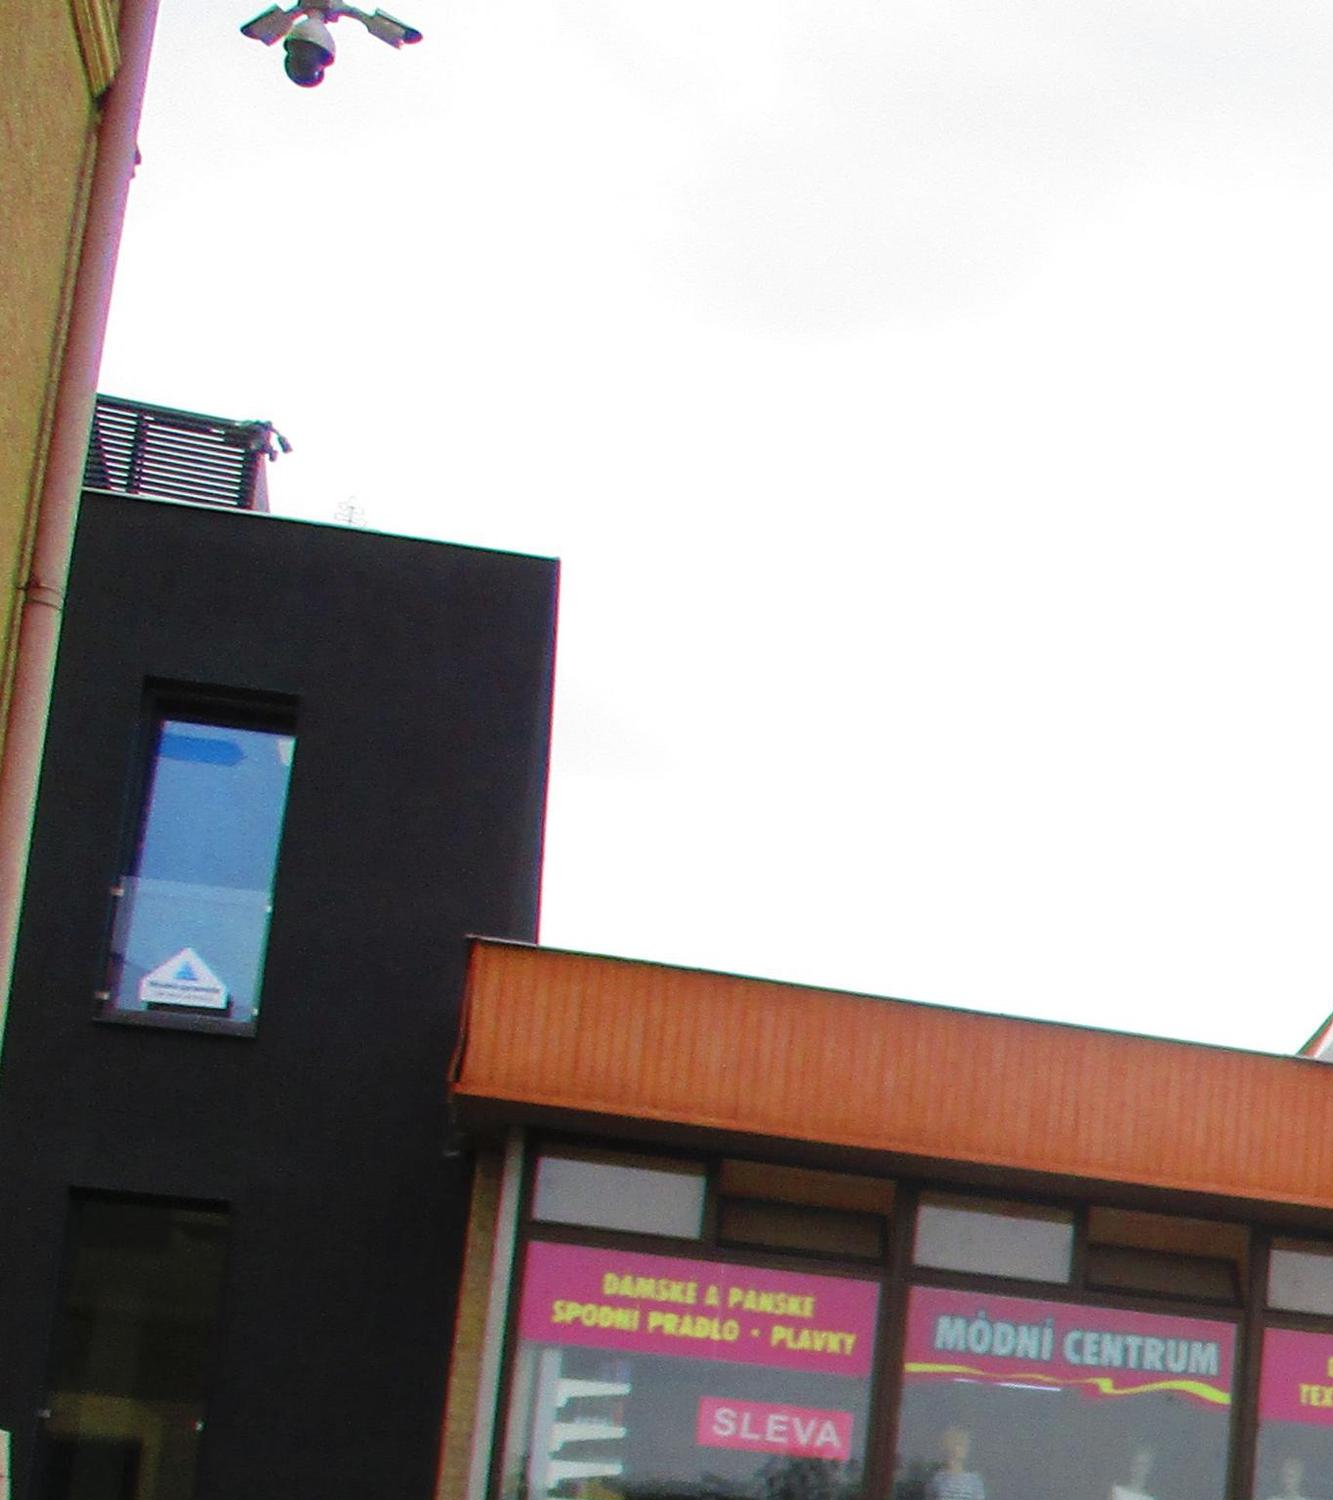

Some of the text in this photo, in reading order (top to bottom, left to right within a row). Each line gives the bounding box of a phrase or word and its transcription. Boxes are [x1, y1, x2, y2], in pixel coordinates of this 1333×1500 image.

[771, 1325, 857, 1356] PLAVKY
[934, 1308, 1221, 1377] MÓDNÍ CENTRUM
[712, 1406, 842, 1449] SLEVA
